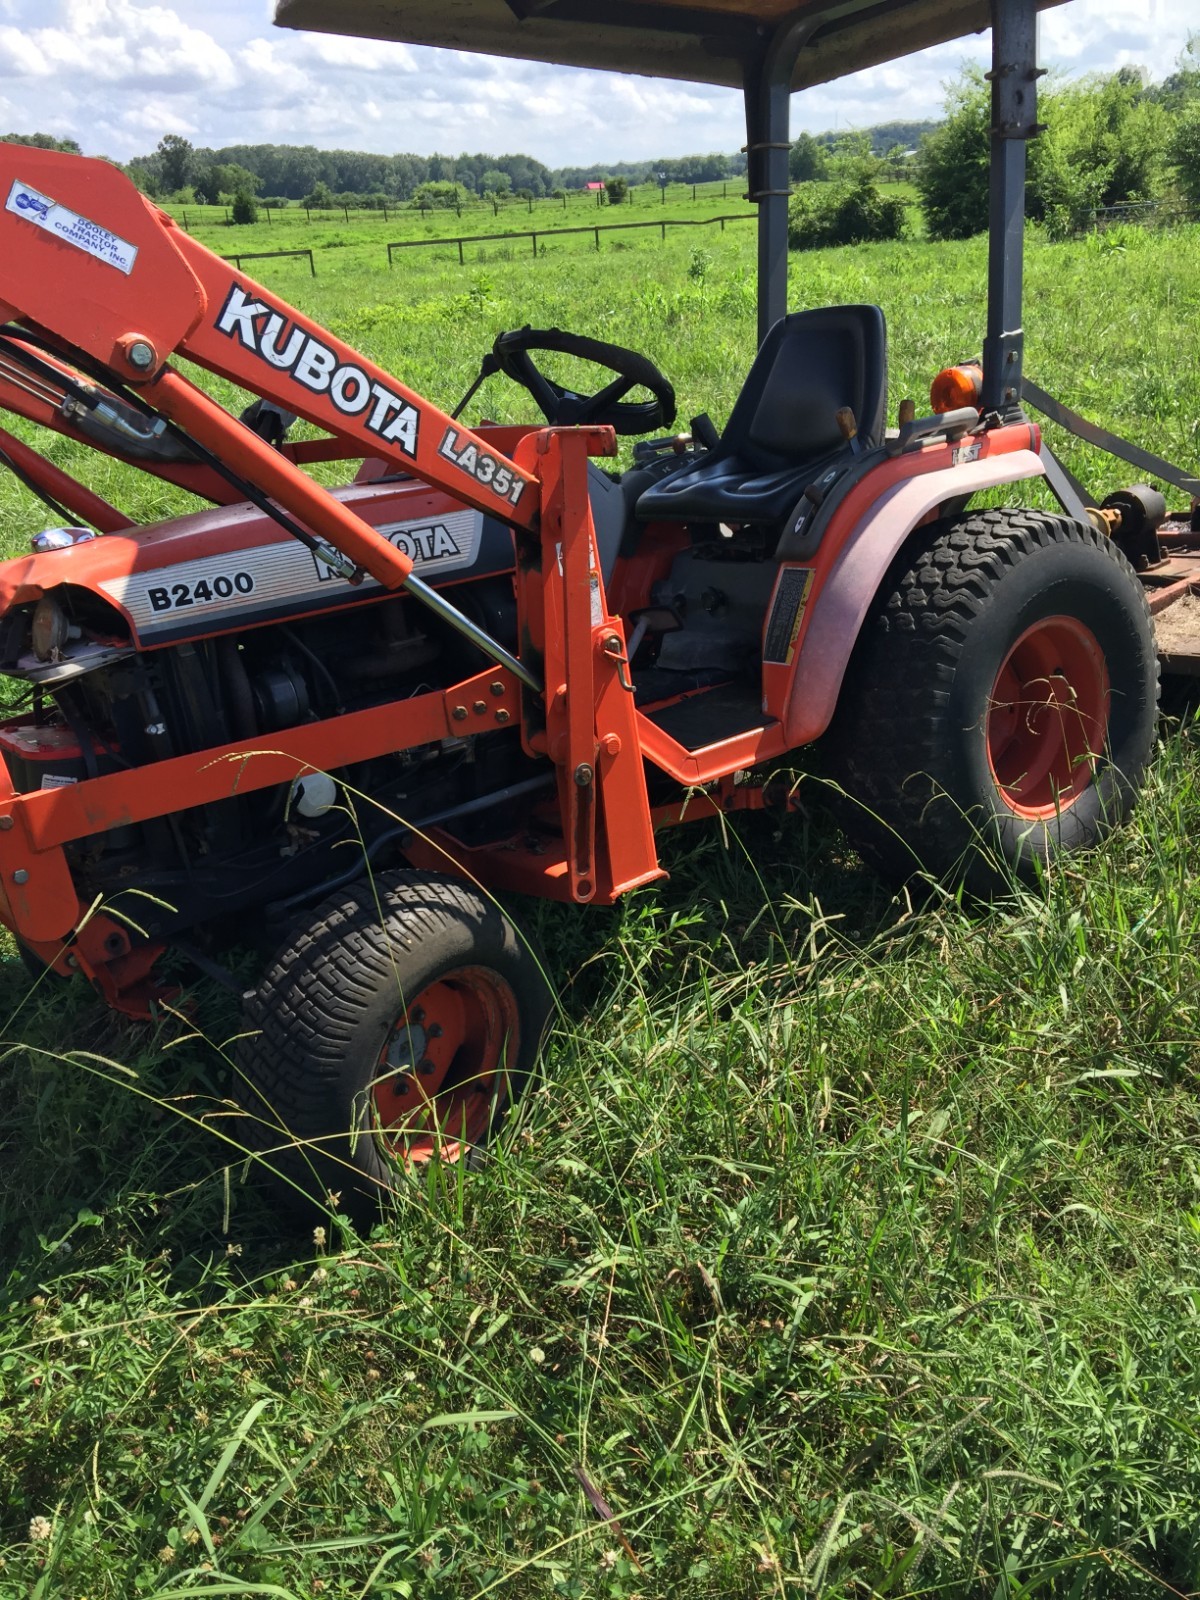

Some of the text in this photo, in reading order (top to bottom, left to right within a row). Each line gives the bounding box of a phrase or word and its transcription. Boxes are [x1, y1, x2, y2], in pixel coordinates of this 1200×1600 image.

[54, 221, 107, 256] COMPANY,
[109, 251, 129, 267] INC.
[72, 222, 119, 252] TRACTOR
[77, 217, 117, 243] DOOLEY
[215, 282, 420, 460] KUBOTA
[439, 427, 526, 507] LA351
[311, 524, 461, 582] KOTA
[147, 572, 254, 611] B2400
